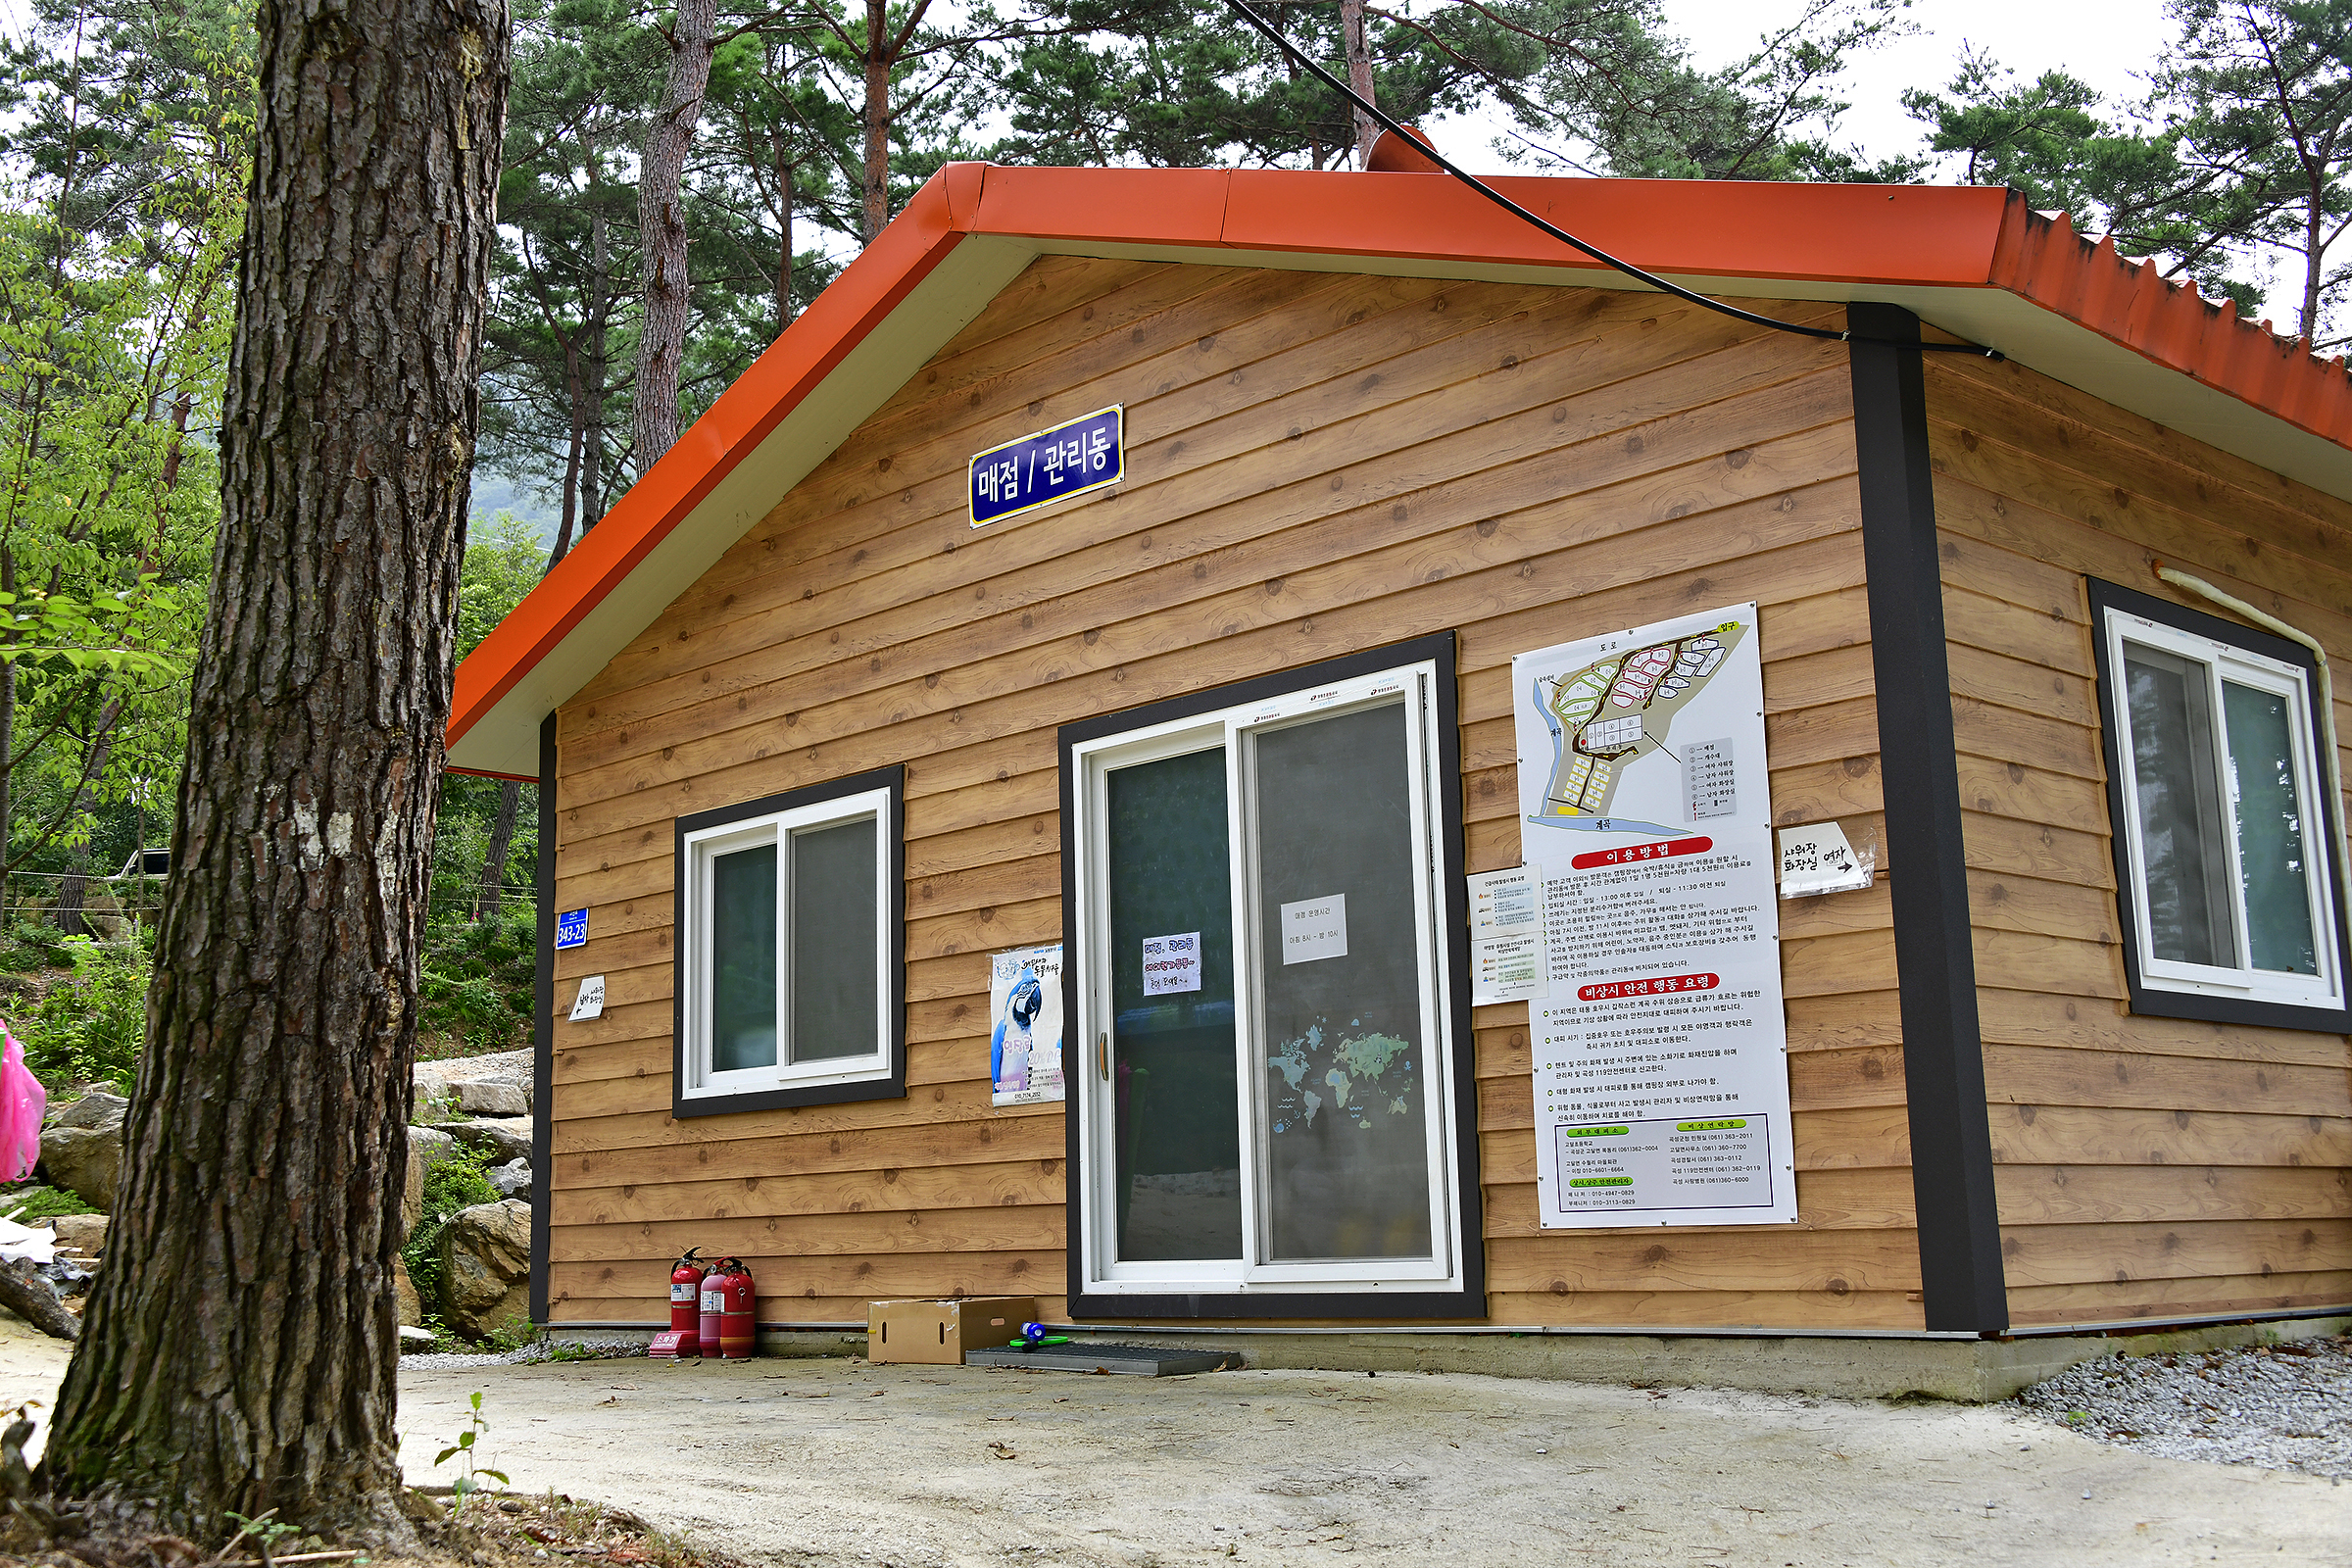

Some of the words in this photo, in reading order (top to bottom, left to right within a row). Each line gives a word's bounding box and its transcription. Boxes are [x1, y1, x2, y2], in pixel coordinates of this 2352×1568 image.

[978, 456, 1018, 502] 매점
[1027, 450, 1036, 493] /
[1043, 427, 1111, 486] 관리동
[1721, 621, 1736, 632] 입구
[1594, 819, 1611, 830] 계곡
[1785, 842, 1817, 858] 샤워장
[1823, 846, 1846, 861] 여자
[1785, 857, 1818, 872] 화장실
[1308, 907, 1331, 918] 운영시간
[558, 923, 585, 944] 343-23
[1327, 929, 1339, 938] 10시
[1169, 937, 1195, 952] 관리동
[1585, 984, 1619, 999] 비상시
[1624, 981, 1648, 995] 안전
[1652, 978, 1679, 992] 행동
[1683, 975, 1708, 988] 요령
[657, 1335, 678, 1344] 소화기
